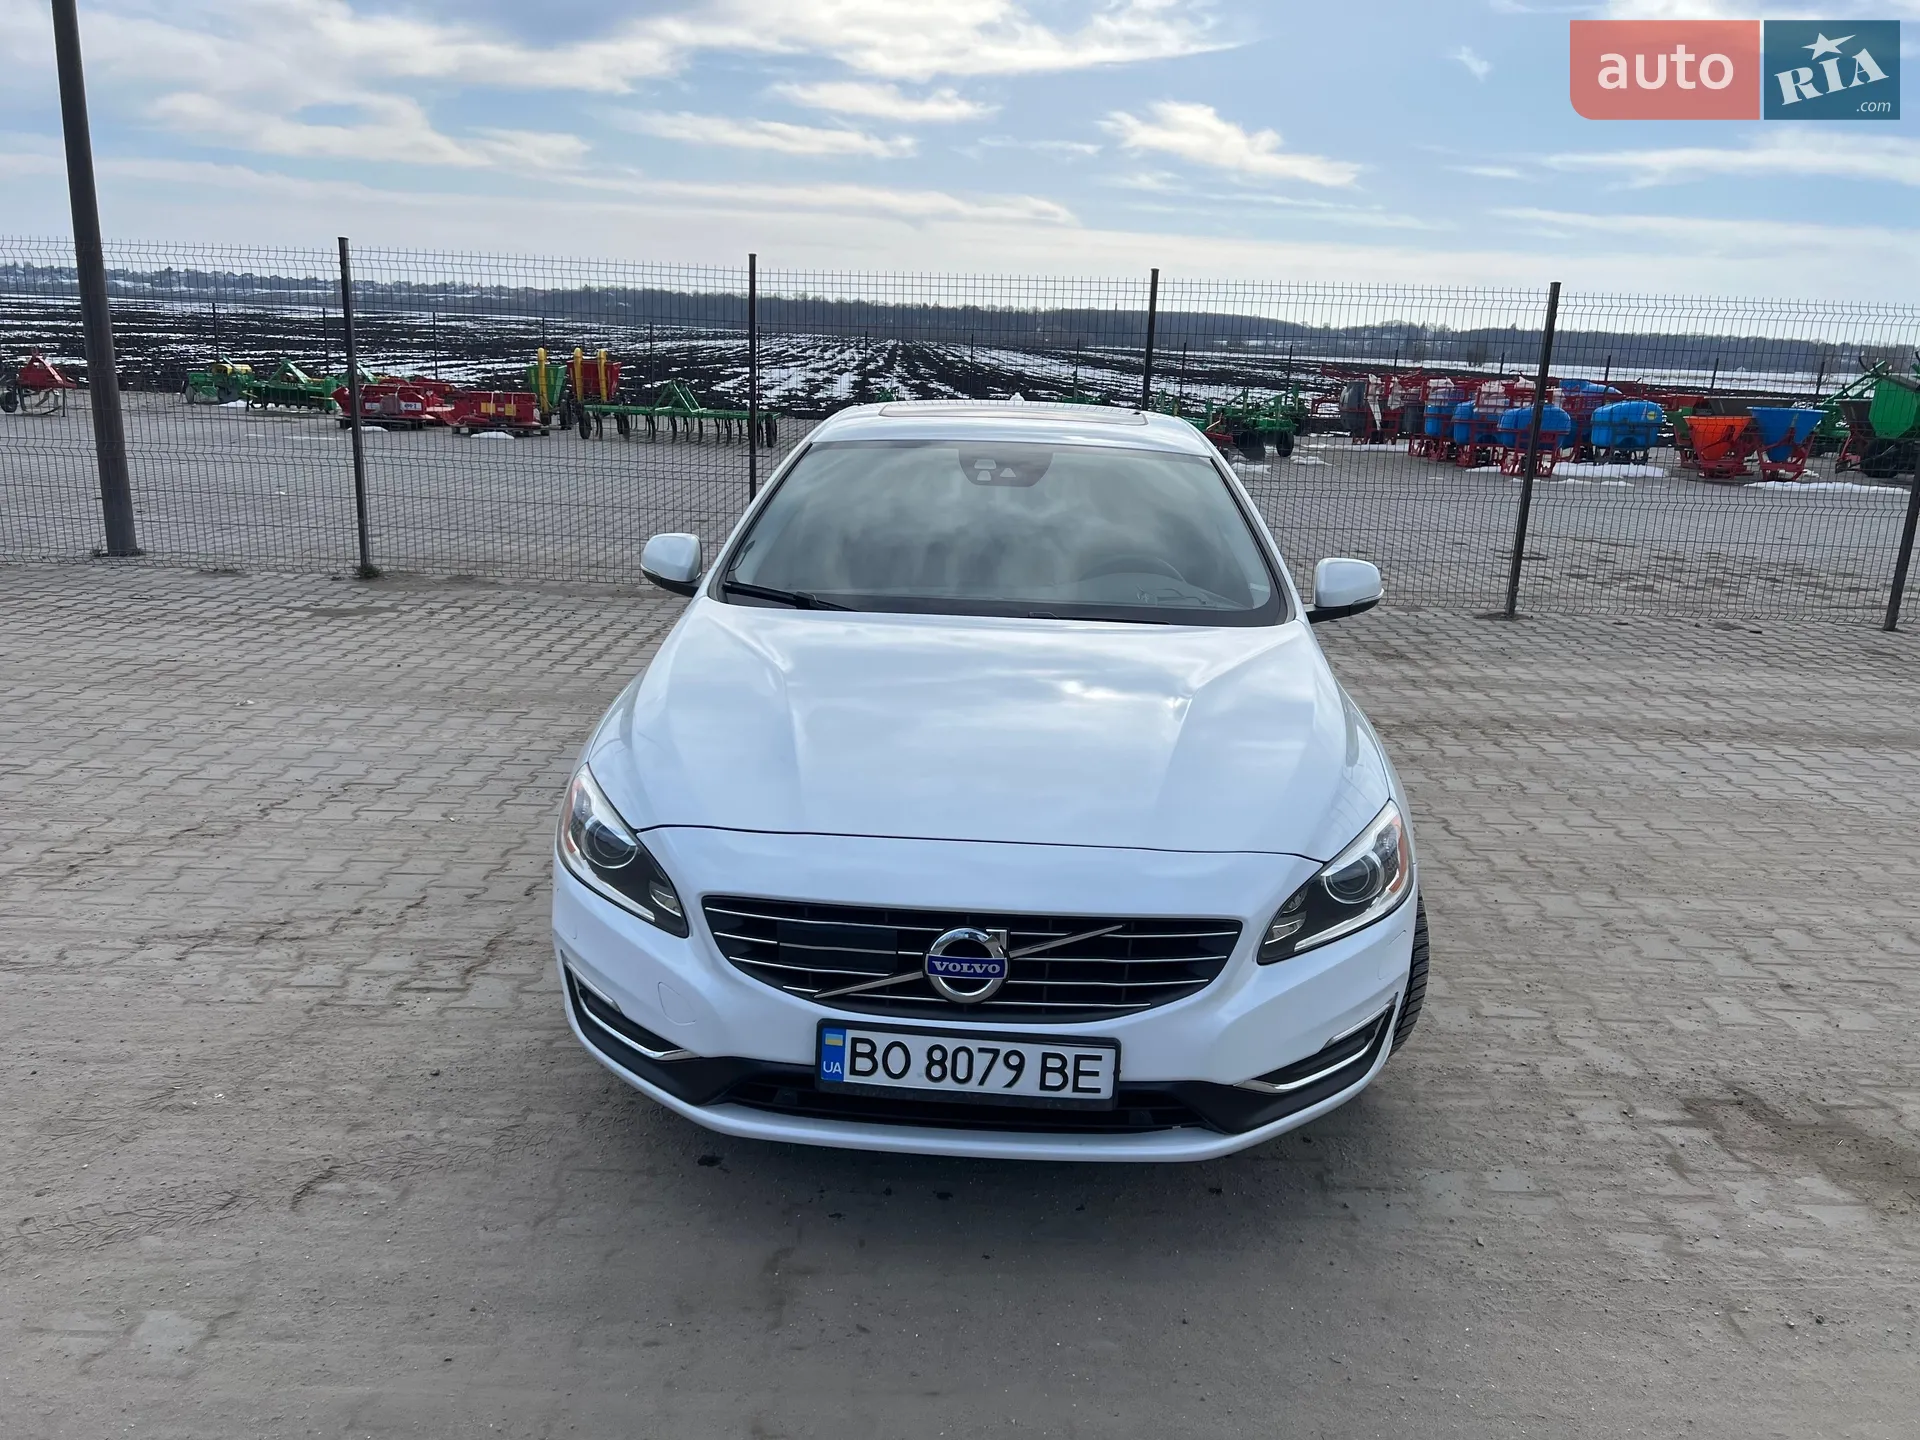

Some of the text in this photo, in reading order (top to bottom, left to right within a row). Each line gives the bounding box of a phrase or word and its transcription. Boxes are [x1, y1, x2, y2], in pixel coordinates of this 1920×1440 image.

[932, 960, 1001, 974] VOLVO
[823, 1061, 843, 1075] UA
[849, 1036, 1103, 1093] BO 8079 BE
